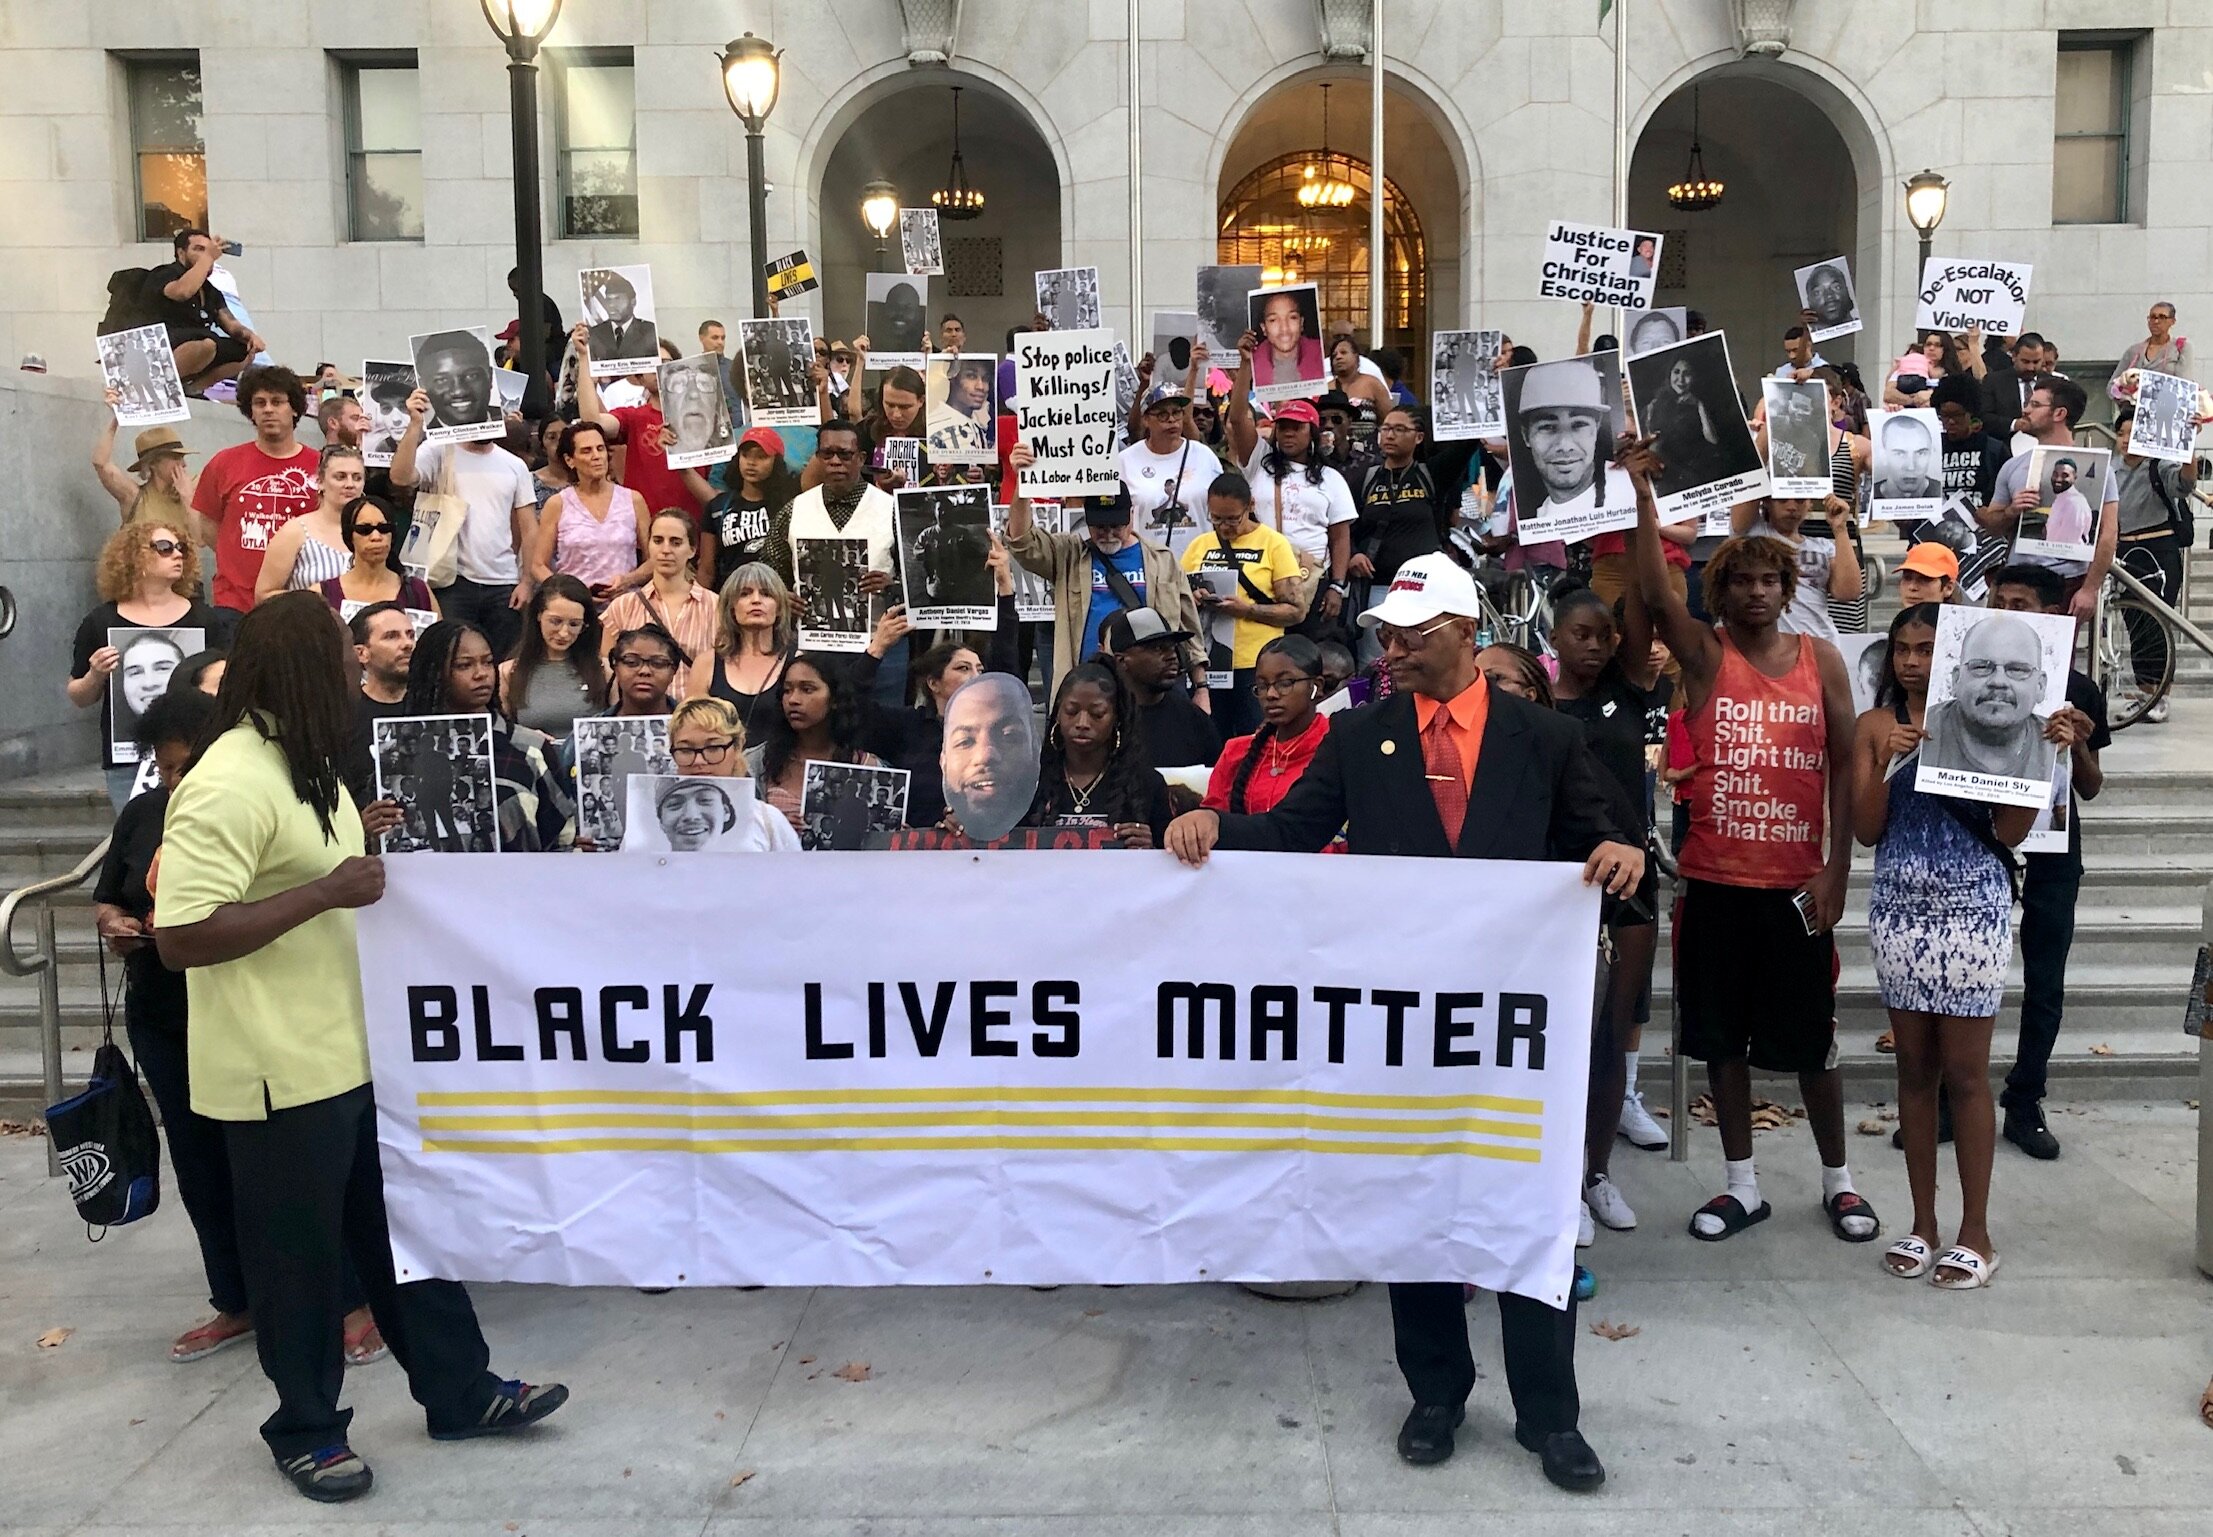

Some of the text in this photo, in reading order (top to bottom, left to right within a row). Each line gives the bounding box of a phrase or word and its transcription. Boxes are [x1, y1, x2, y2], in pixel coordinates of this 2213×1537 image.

[1550, 226, 1630, 252] Justice
[1574, 248, 1610, 267] For
[1542, 262, 1640, 291] Christian
[1540, 280, 1645, 308] Escobedo
[1955, 288, 1995, 304] NOT
[1933, 311, 2008, 332] Violence
[1022, 345, 1112, 371] Stop police
[1030, 370, 1111, 401] Killings!
[1019, 404, 1116, 430] Jackie Lacey
[887, 440, 917, 459] JACKIE
[1032, 430, 1116, 460] Must Go!
[1943, 451, 1981, 468] LACK
[1075, 468, 1083, 483] 4
[1086, 468, 1120, 483] Bernie
[1942, 470, 1976, 487] IVES
[1381, 489, 1425, 500] AELES
[1682, 488, 1712, 501] Melyda
[1520, 507, 1636, 531] Matthew Jonathan Luis Hurtado
[242, 538, 265, 548] UTLA
[1206, 551, 1258, 560] No man
[1092, 568, 1144, 584] Bni
[1411, 571, 1427, 580] NBA
[1715, 697, 1818, 725] Roll that
[1715, 721, 1772, 744] Shit.
[1714, 743, 1778, 771] Light
[1714, 770, 1770, 795] Shit.
[1938, 771, 2031, 792] Mark Daniel Sly
[1712, 793, 1797, 820] Smoke
[1712, 815, 1768, 841] That
[408, 981, 1547, 1070] BLACK LIVES MATTER
[1894, 1241, 1925, 1254] FILA
[1943, 1251, 1978, 1268] FILA
